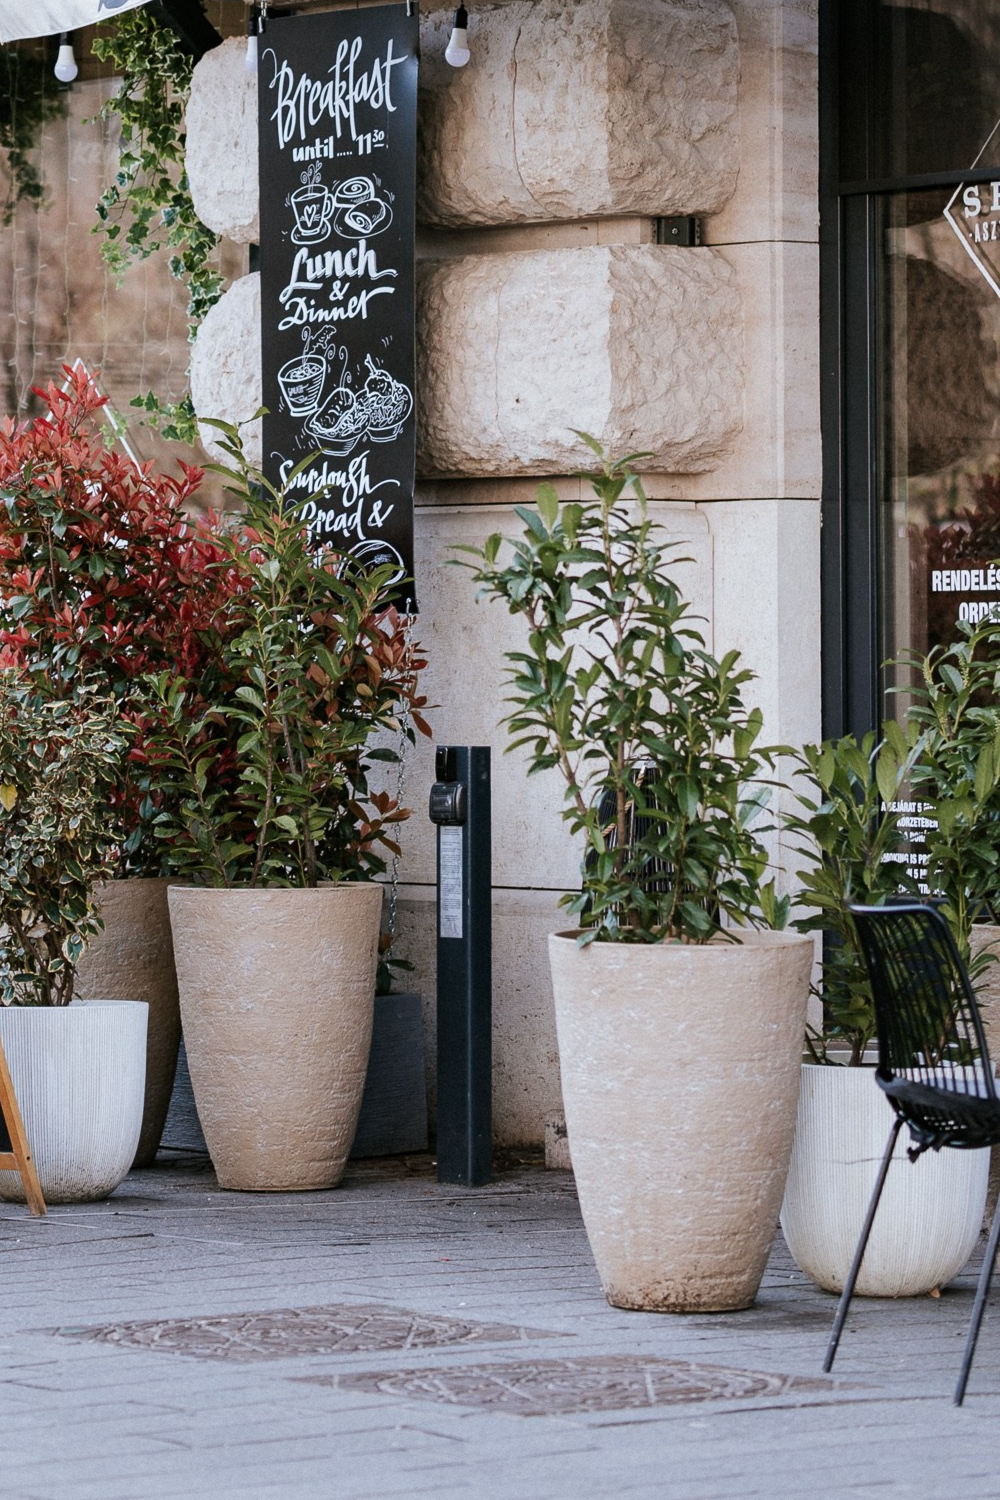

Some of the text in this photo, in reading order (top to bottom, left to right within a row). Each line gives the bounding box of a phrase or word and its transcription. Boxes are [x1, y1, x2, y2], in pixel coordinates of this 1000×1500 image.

[262, 36, 408, 150] Breakfast
[292, 135, 334, 162] until
[279, 239, 398, 304] Lunch
[329, 280, 350, 301] &
[278, 287, 396, 331] Dinner
[367, 499, 395, 528] &
